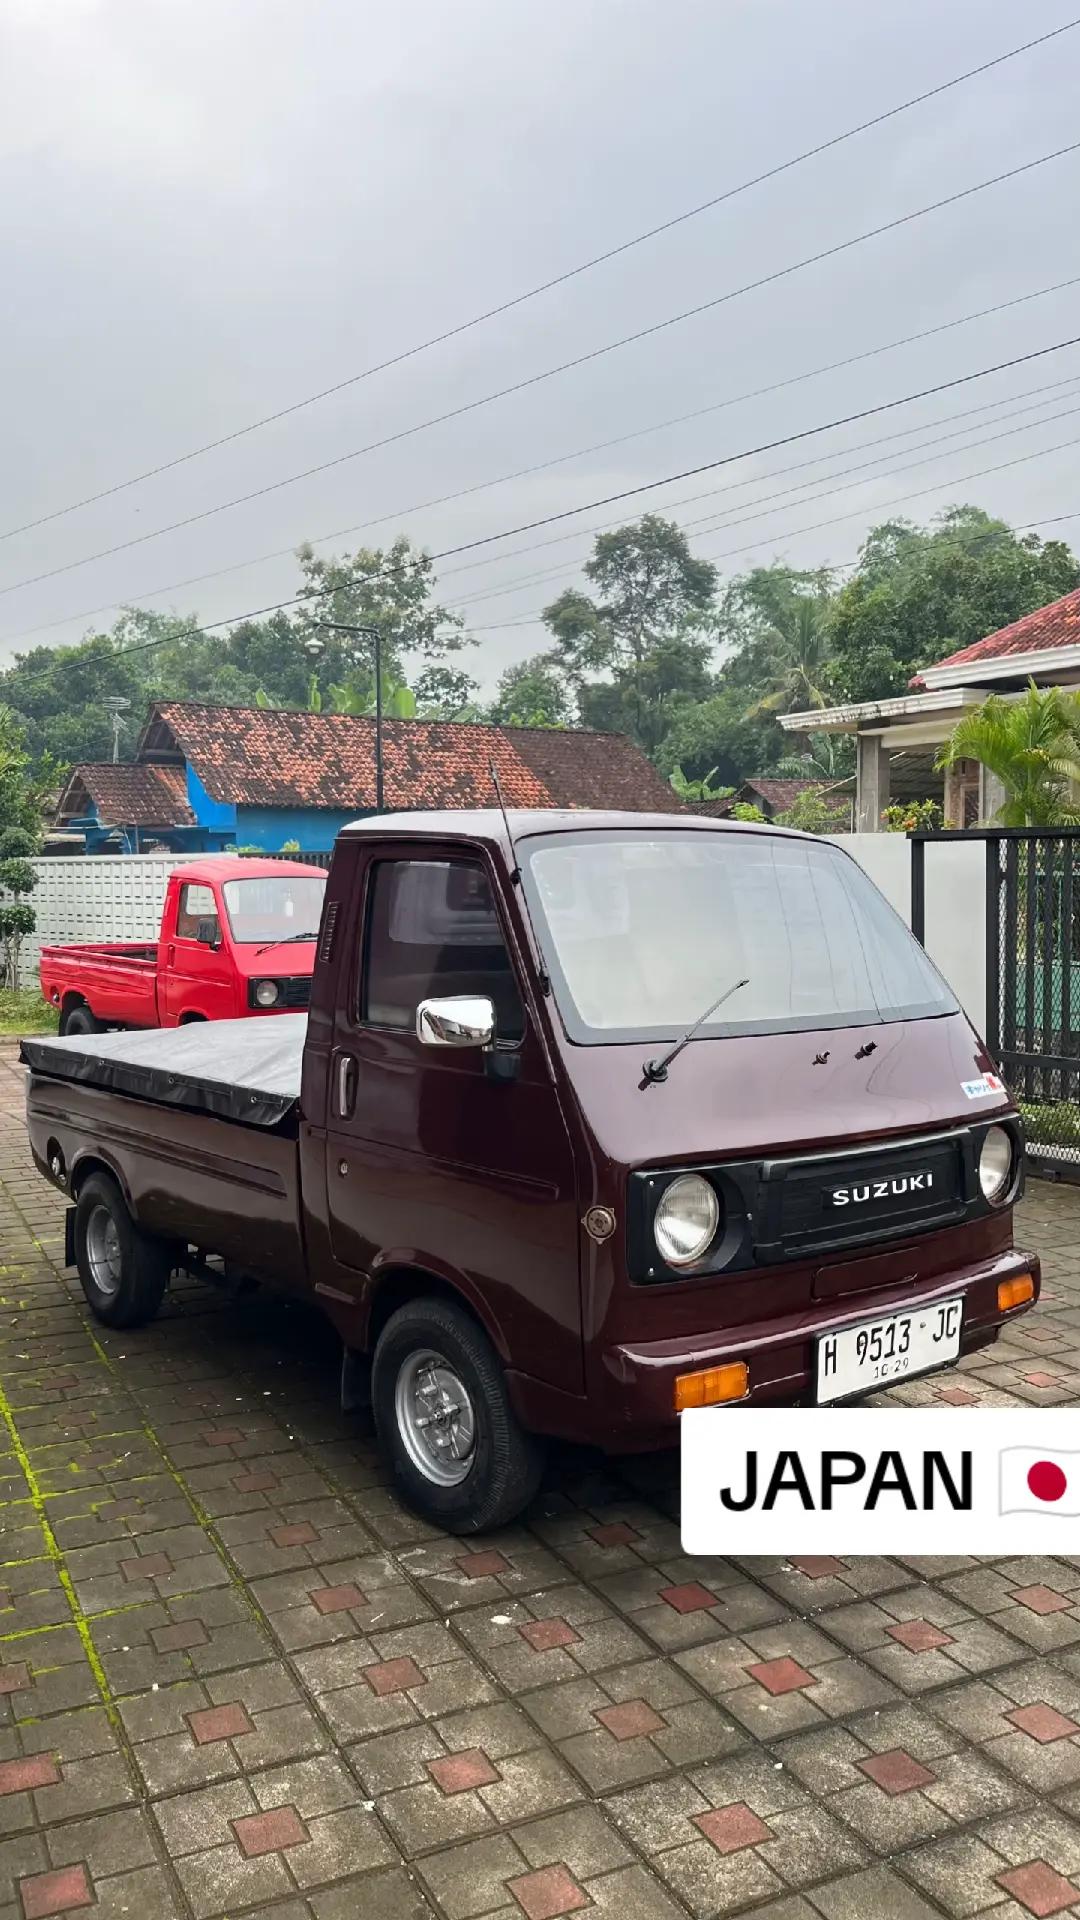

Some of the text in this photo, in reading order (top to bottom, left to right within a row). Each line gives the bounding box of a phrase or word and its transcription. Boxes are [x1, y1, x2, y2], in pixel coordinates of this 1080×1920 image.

[832, 1173, 934, 1206] SUZUKI
[824, 1306, 959, 1377] H 9513 JC
